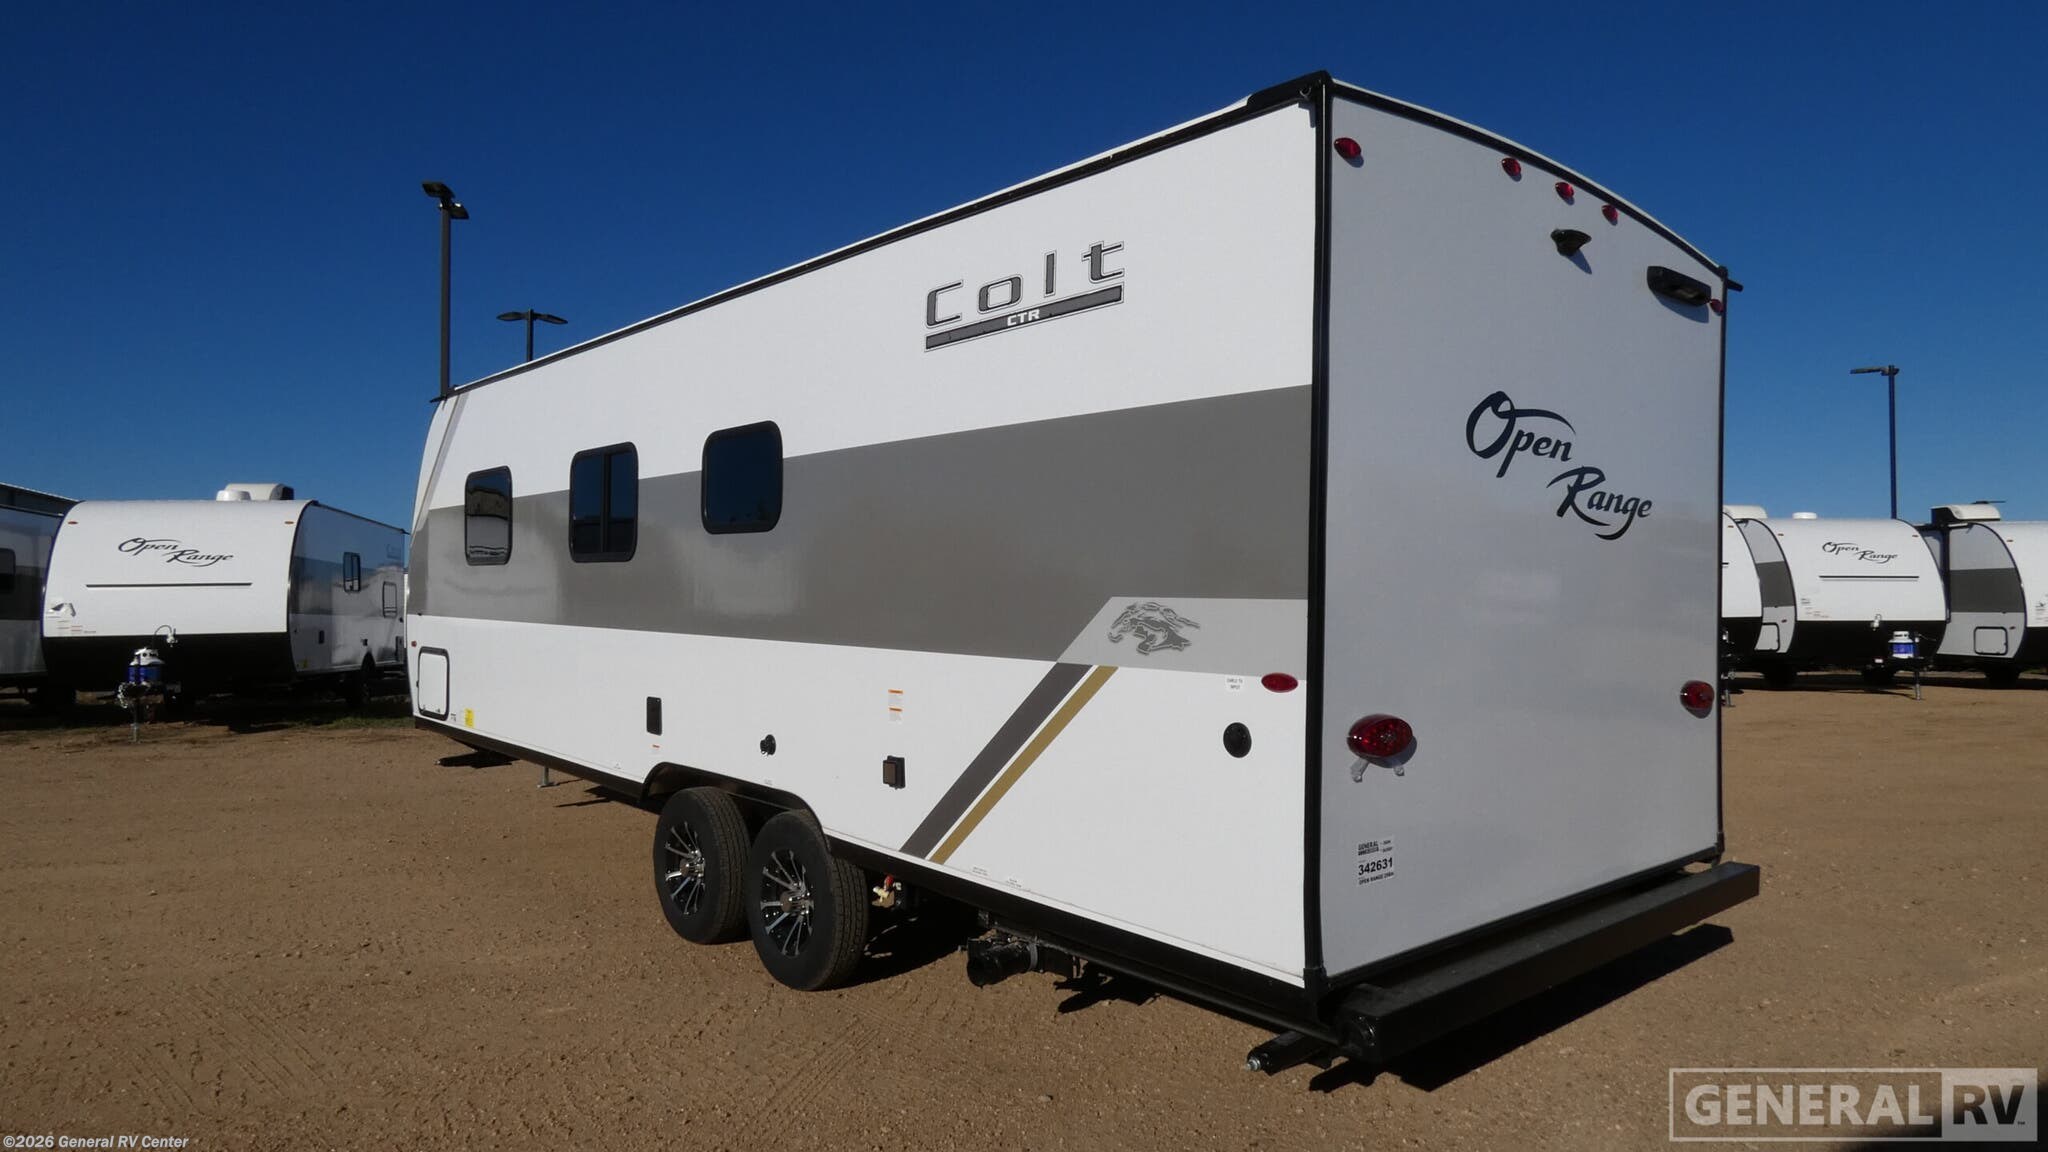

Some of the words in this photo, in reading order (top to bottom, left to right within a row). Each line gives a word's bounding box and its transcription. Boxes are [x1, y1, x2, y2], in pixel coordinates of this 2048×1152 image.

[926, 240, 1124, 328] Colt
[1007, 308, 1040, 327] CTR
[1466, 390, 1576, 478] Open
[1546, 465, 1652, 541] Range
[118, 537, 182, 556] Open
[1822, 541, 1859, 556] Open
[161, 549, 234, 568] Range
[1853, 549, 1898, 564] Range
[1358, 857, 1393, 876] 342631
